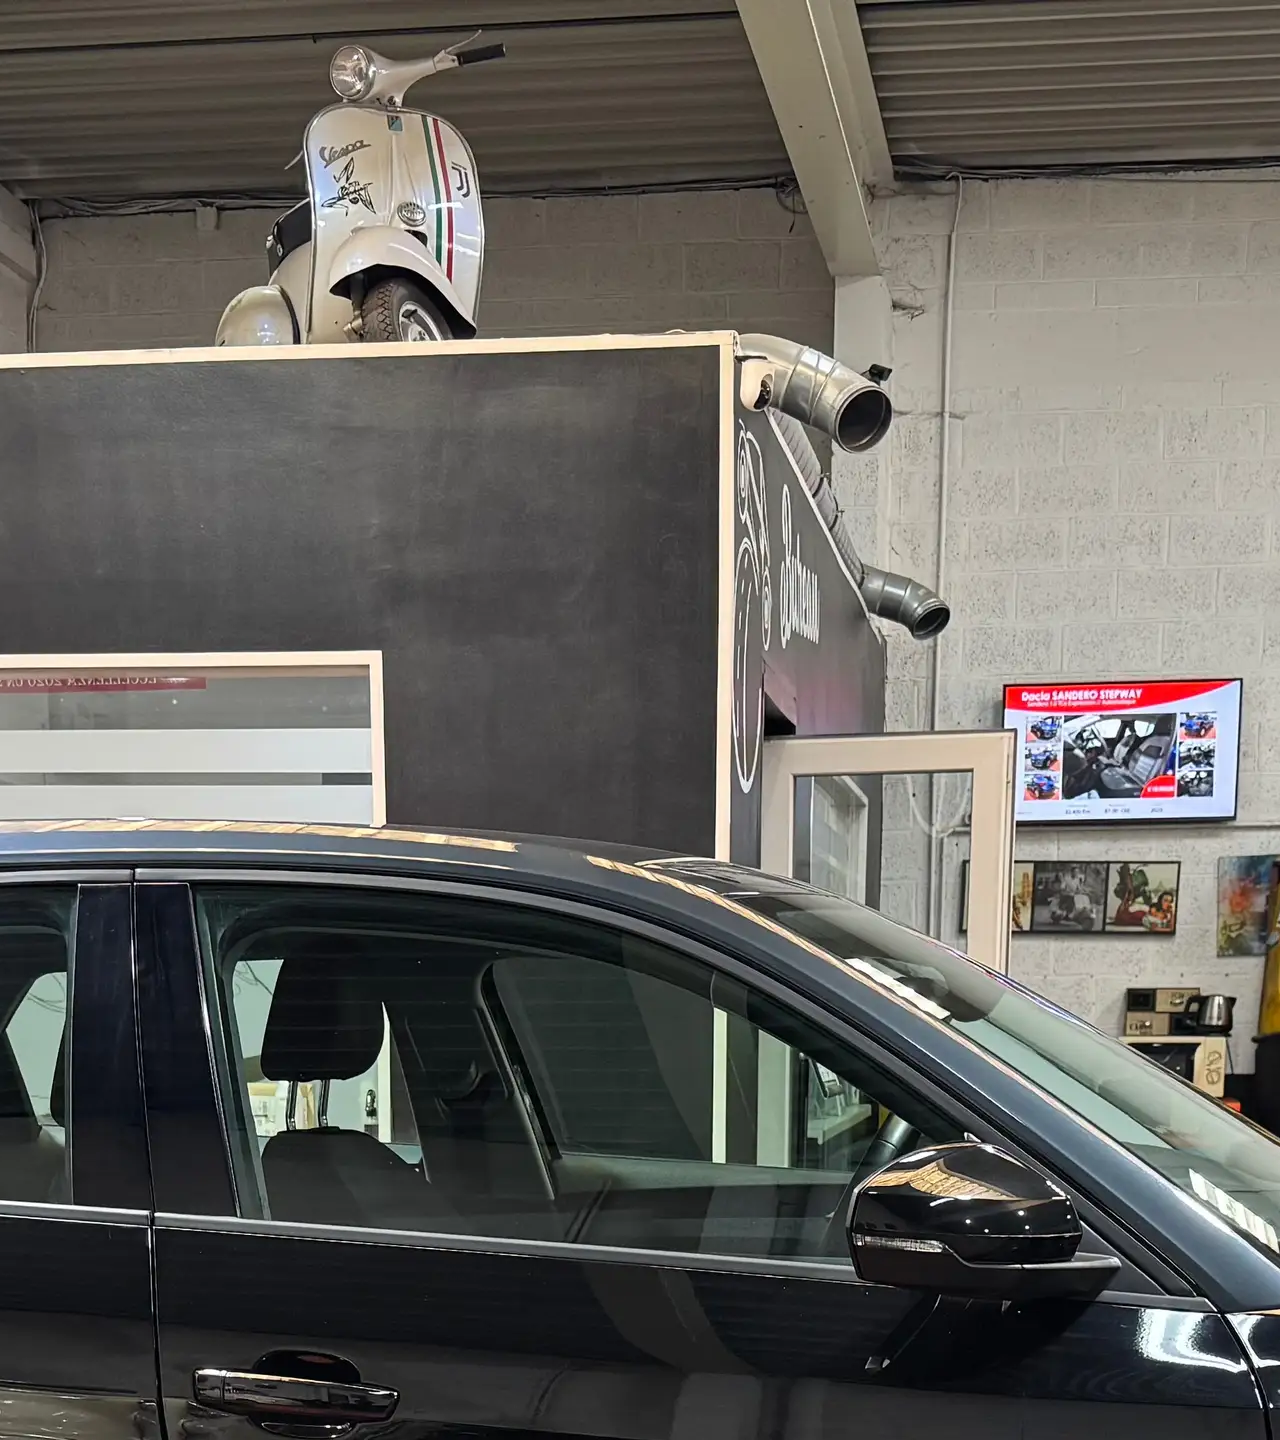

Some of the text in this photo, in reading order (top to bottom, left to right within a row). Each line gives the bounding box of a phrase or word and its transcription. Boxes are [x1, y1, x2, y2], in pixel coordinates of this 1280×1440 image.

[319, 139, 372, 169] Vespa
[1021, 688, 1143, 701] Dacia SANDERO STEPWAY
